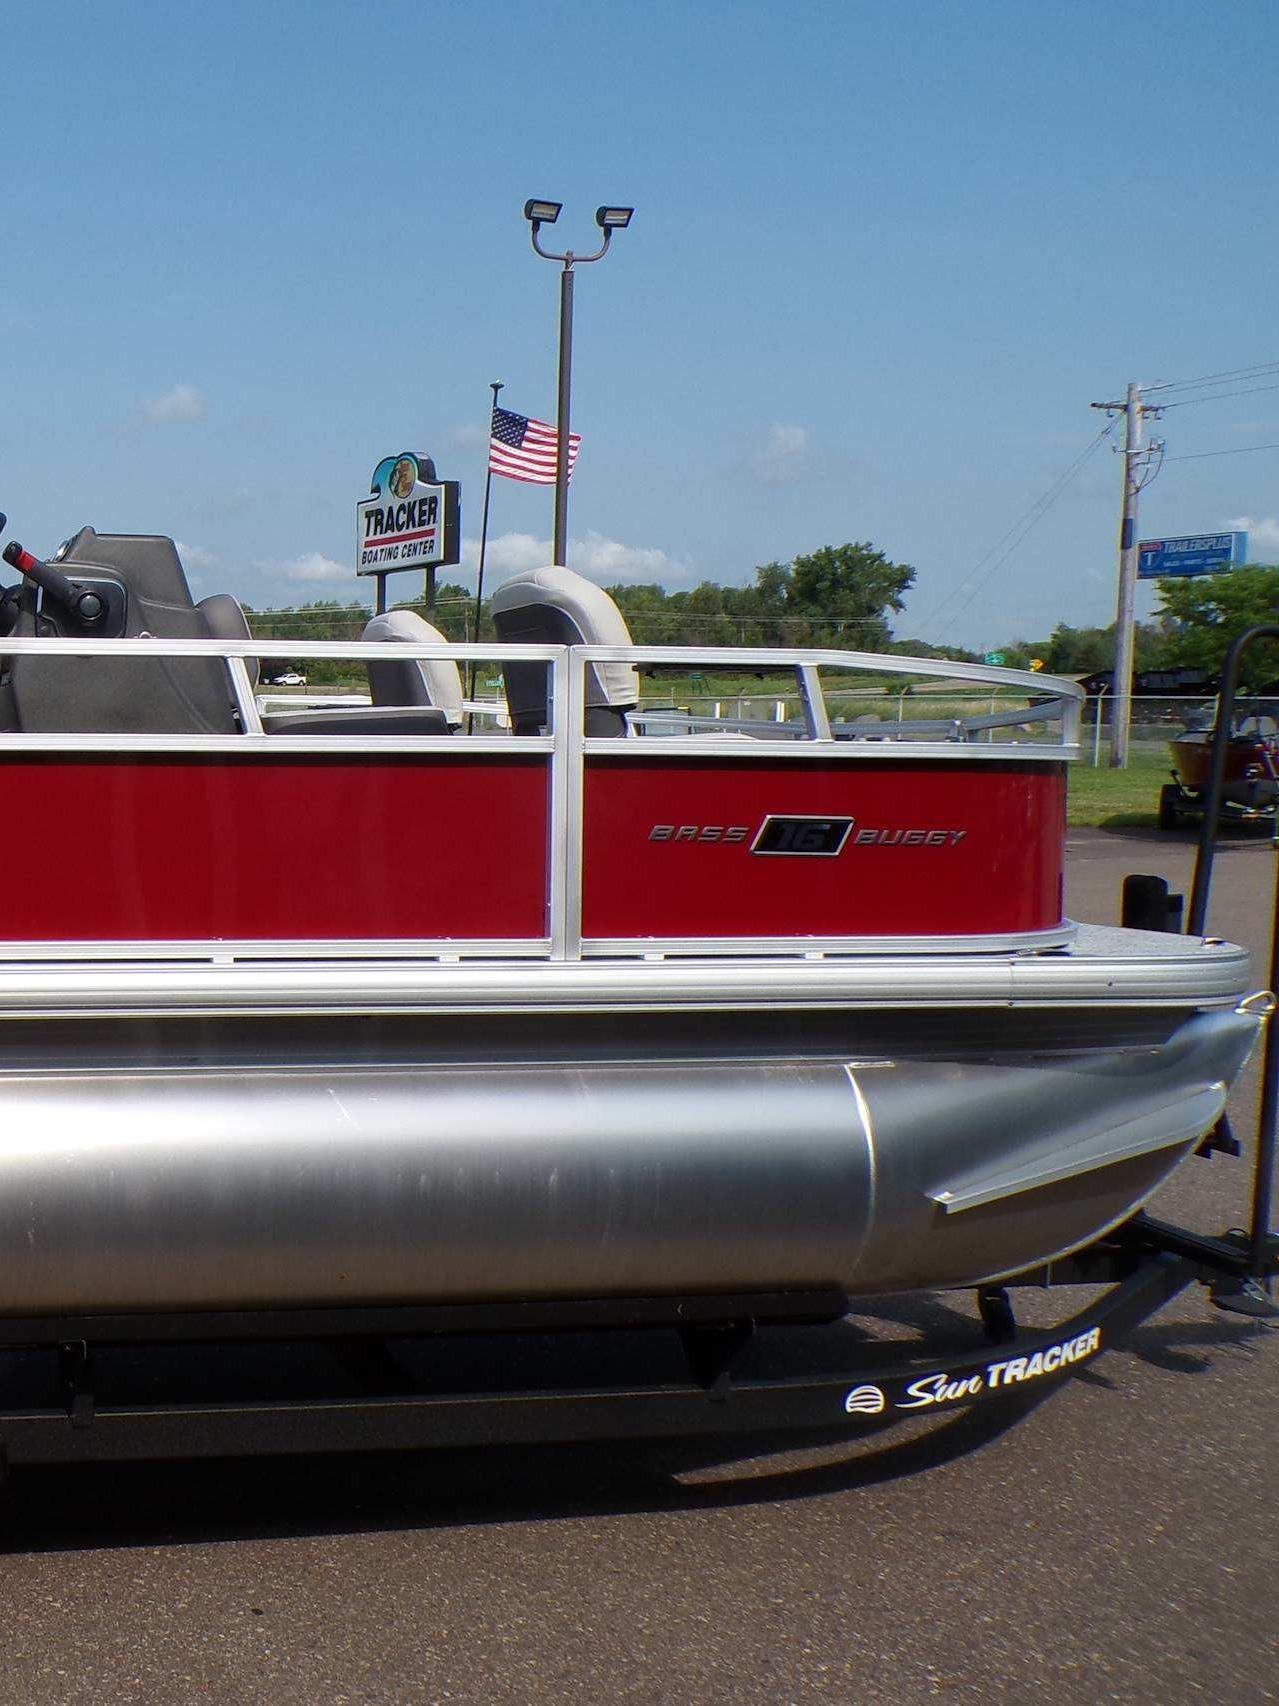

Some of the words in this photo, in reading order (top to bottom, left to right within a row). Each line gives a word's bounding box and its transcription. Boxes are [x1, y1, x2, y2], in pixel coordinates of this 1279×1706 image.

[364, 495, 438, 538] TRACKER
[361, 546, 399, 565] BOATING
[400, 539, 435, 559] CENTER
[648, 824, 750, 843] BASS
[774, 822, 831, 849] 16
[854, 829, 968, 846] BUGGY
[894, 1373, 984, 1409] Sun
[986, 1326, 1101, 1388] TRACKER
